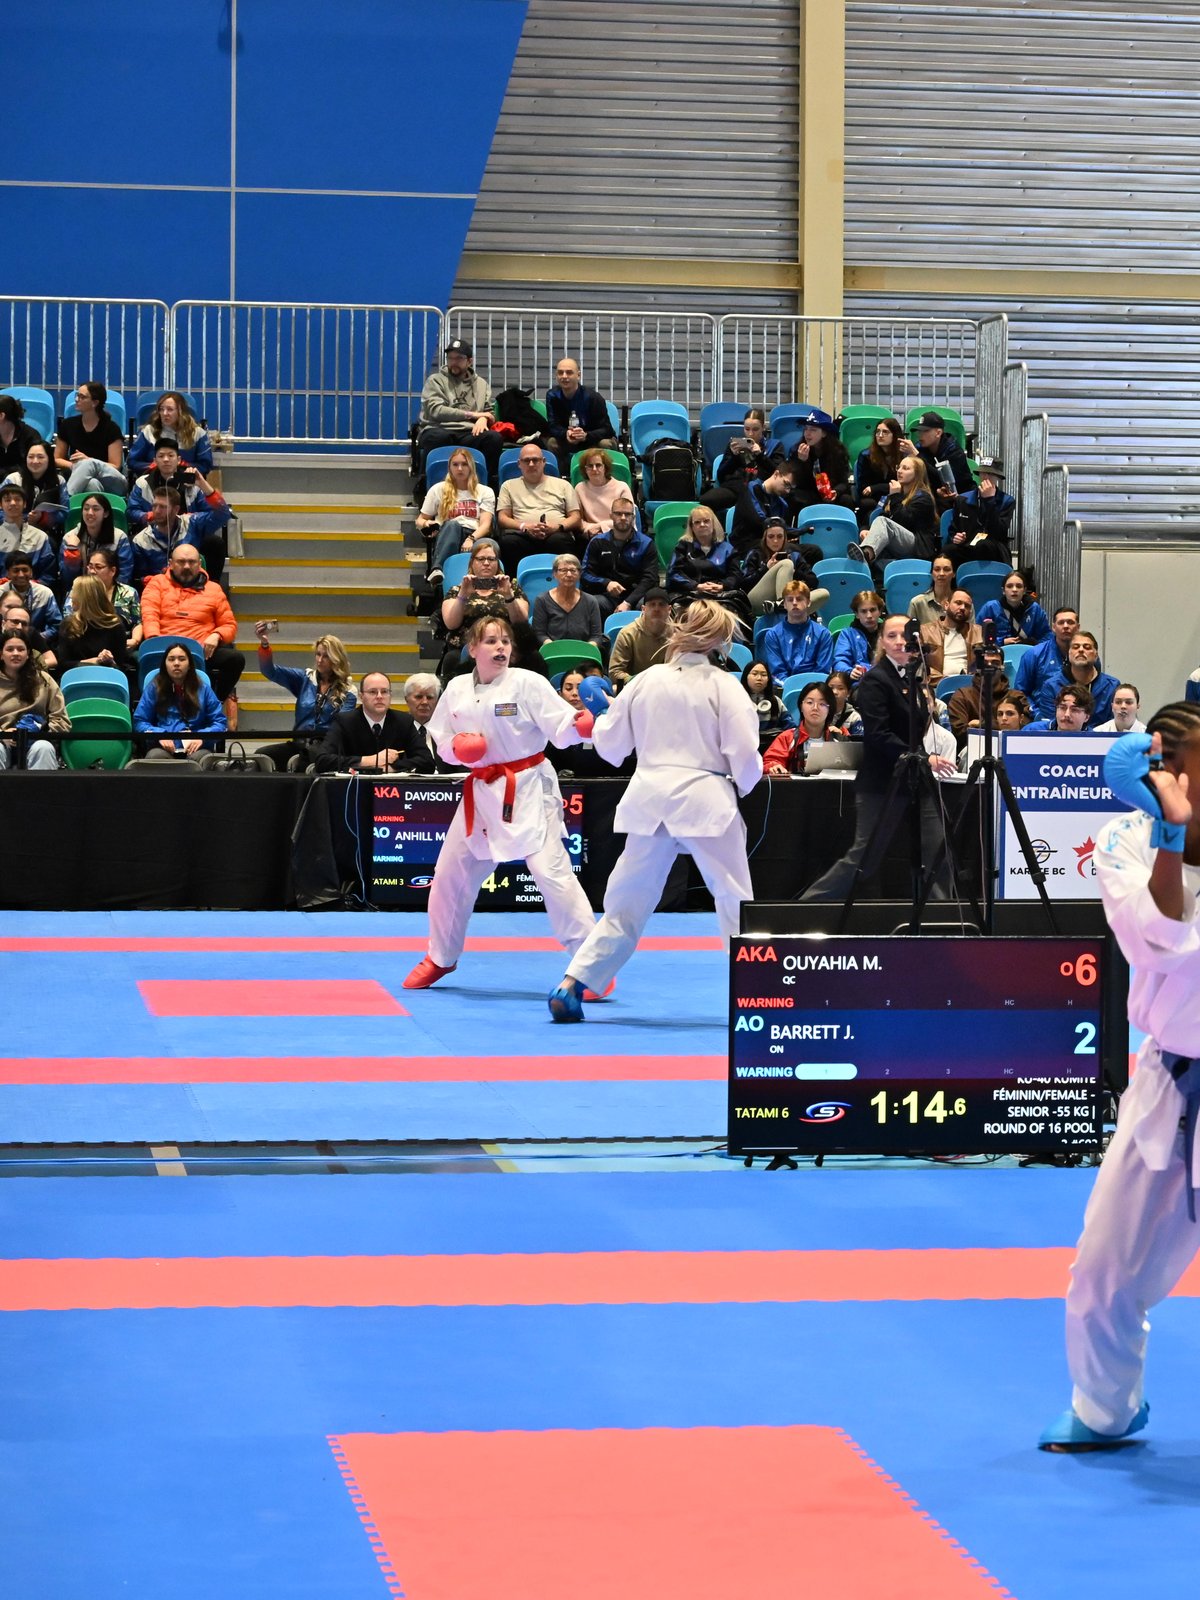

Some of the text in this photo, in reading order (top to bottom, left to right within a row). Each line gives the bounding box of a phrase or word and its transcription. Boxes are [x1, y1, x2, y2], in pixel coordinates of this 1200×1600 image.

[1039, 765, 1099, 778] COACH
[404, 791, 453, 802] DAVISON
[394, 831, 433, 841] ANHILL
[568, 833, 583, 855] 3
[1010, 867, 1066, 875] KARE BC
[372, 878, 405, 886] ATAMI 3
[515, 895, 544, 903] ROUND
[735, 946, 778, 962] AKA
[782, 955, 883, 971] OUYAHIA M.
[782, 975, 796, 985] QC
[737, 997, 795, 1008] WARNING
[734, 1015, 765, 1032] AO
[770, 1024, 855, 1040] BARRETT J.
[1073, 1021, 1097, 1055] 2
[769, 1045, 784, 1054] ON
[735, 1066, 793, 1078] WARNING
[993, 1087, 1088, 1102] FÉMININ/FEMALE
[735, 1107, 789, 1119] TATAMI 6
[1007, 1105, 1050, 1118] SENIOR
[1052, 1105, 1071, 1118] -55
[1073, 1105, 1090, 1118] KG
[983, 1122, 1096, 1134] ROUND OF 16 POOL
